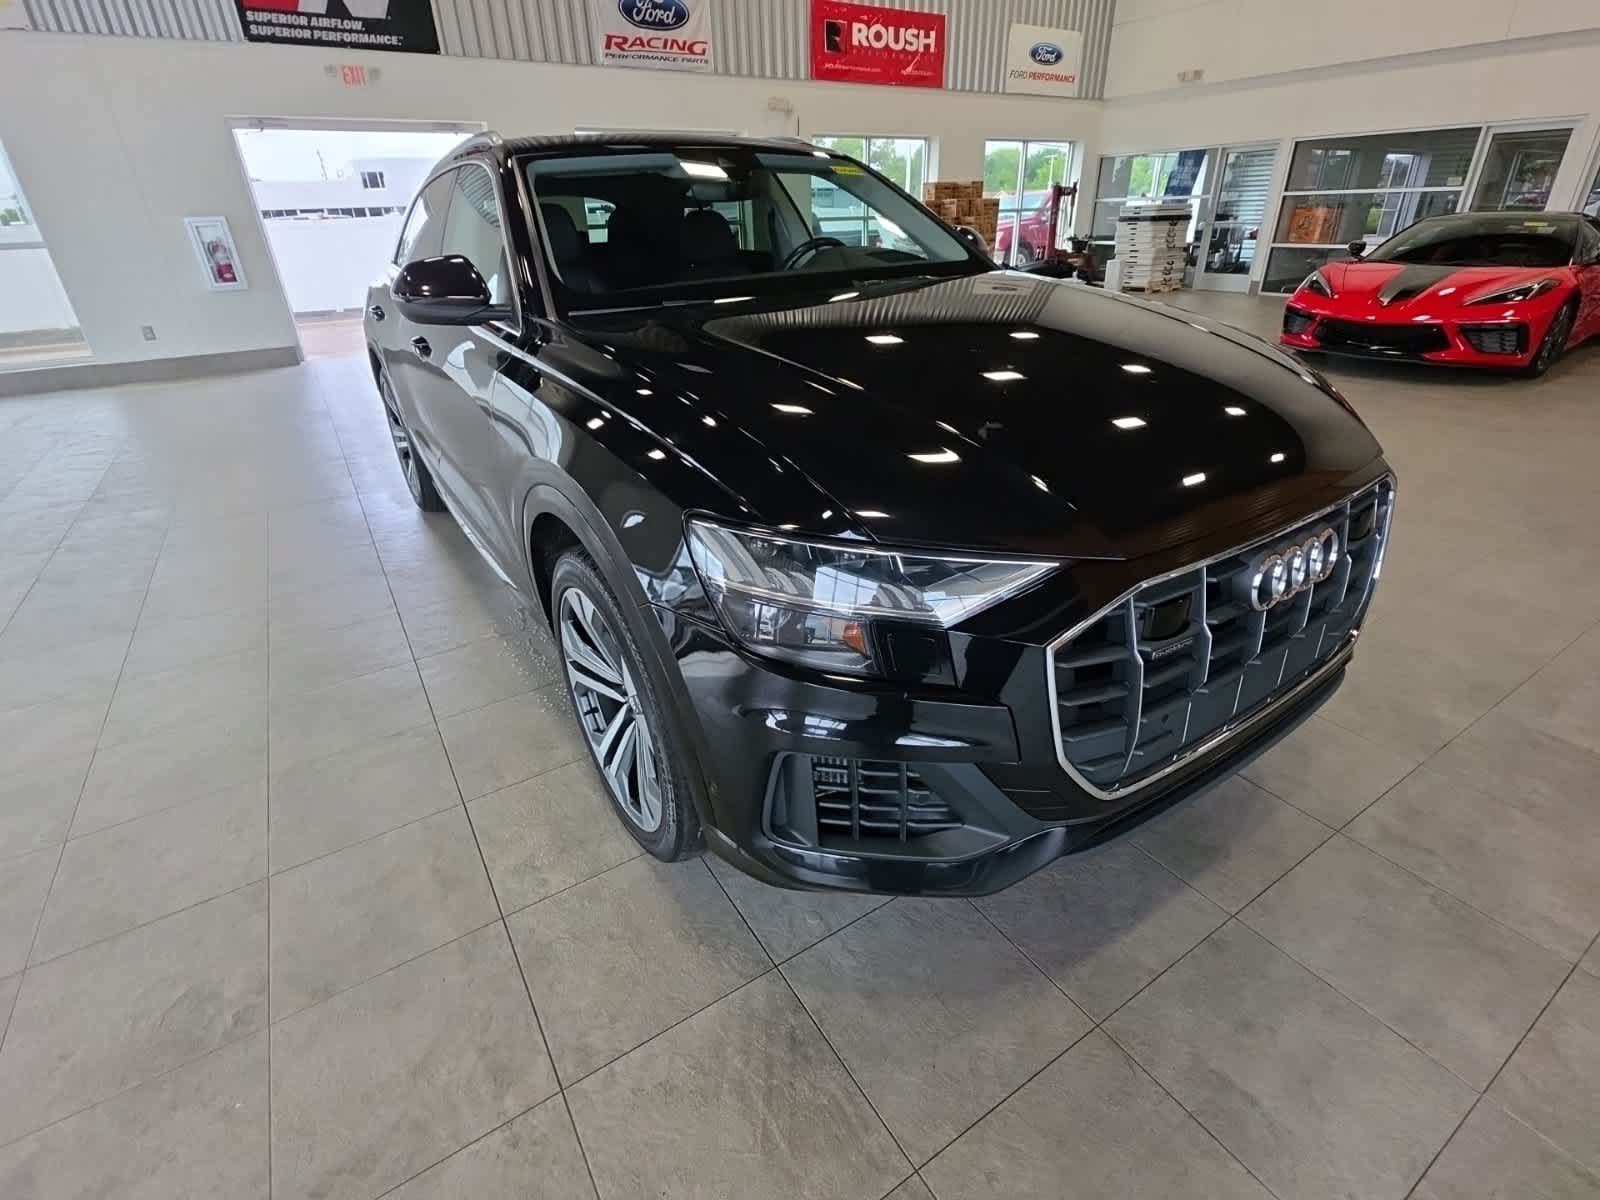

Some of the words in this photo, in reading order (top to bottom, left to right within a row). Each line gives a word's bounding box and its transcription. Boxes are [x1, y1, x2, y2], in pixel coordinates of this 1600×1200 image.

[246, 11, 308, 26] SUPERIOR
[310, 17, 366, 31] AIRFLOW.
[632, 0, 677, 24] Ford
[249, 24, 313, 39] SUPERIOR
[851, 22, 936, 53] ROUSH
[604, 33, 708, 56] RACING
[1036, 46, 1058, 62] Ford
[342, 64, 368, 87] EXIT
[1009, 70, 1028, 80] FORD
